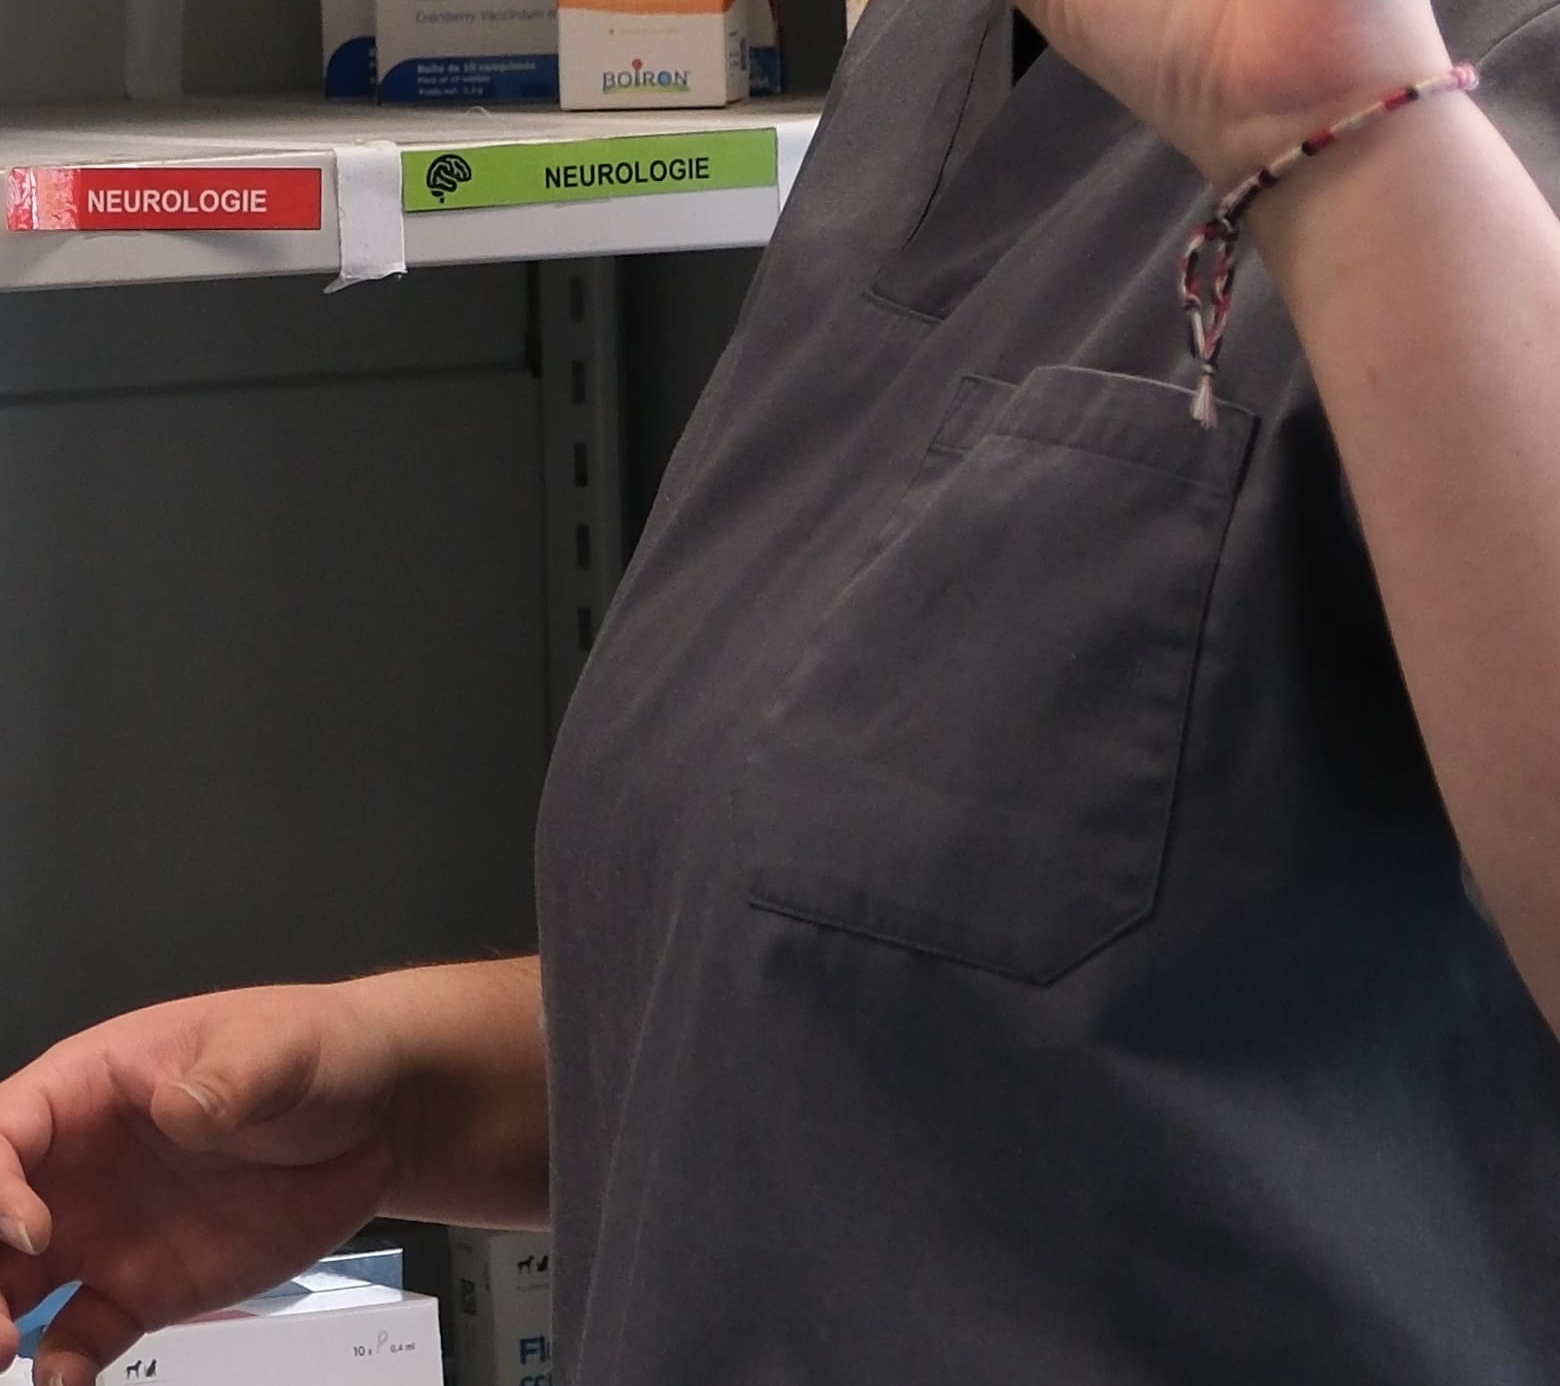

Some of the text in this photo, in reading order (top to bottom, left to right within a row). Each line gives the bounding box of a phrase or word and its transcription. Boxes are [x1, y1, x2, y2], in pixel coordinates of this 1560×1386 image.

[602, 61, 689, 92] BOIRON
[543, 154, 711, 190] NEUROLOGIE
[87, 185, 268, 217] NEUROLOGIE
[352, 1345, 366, 1358] 10
